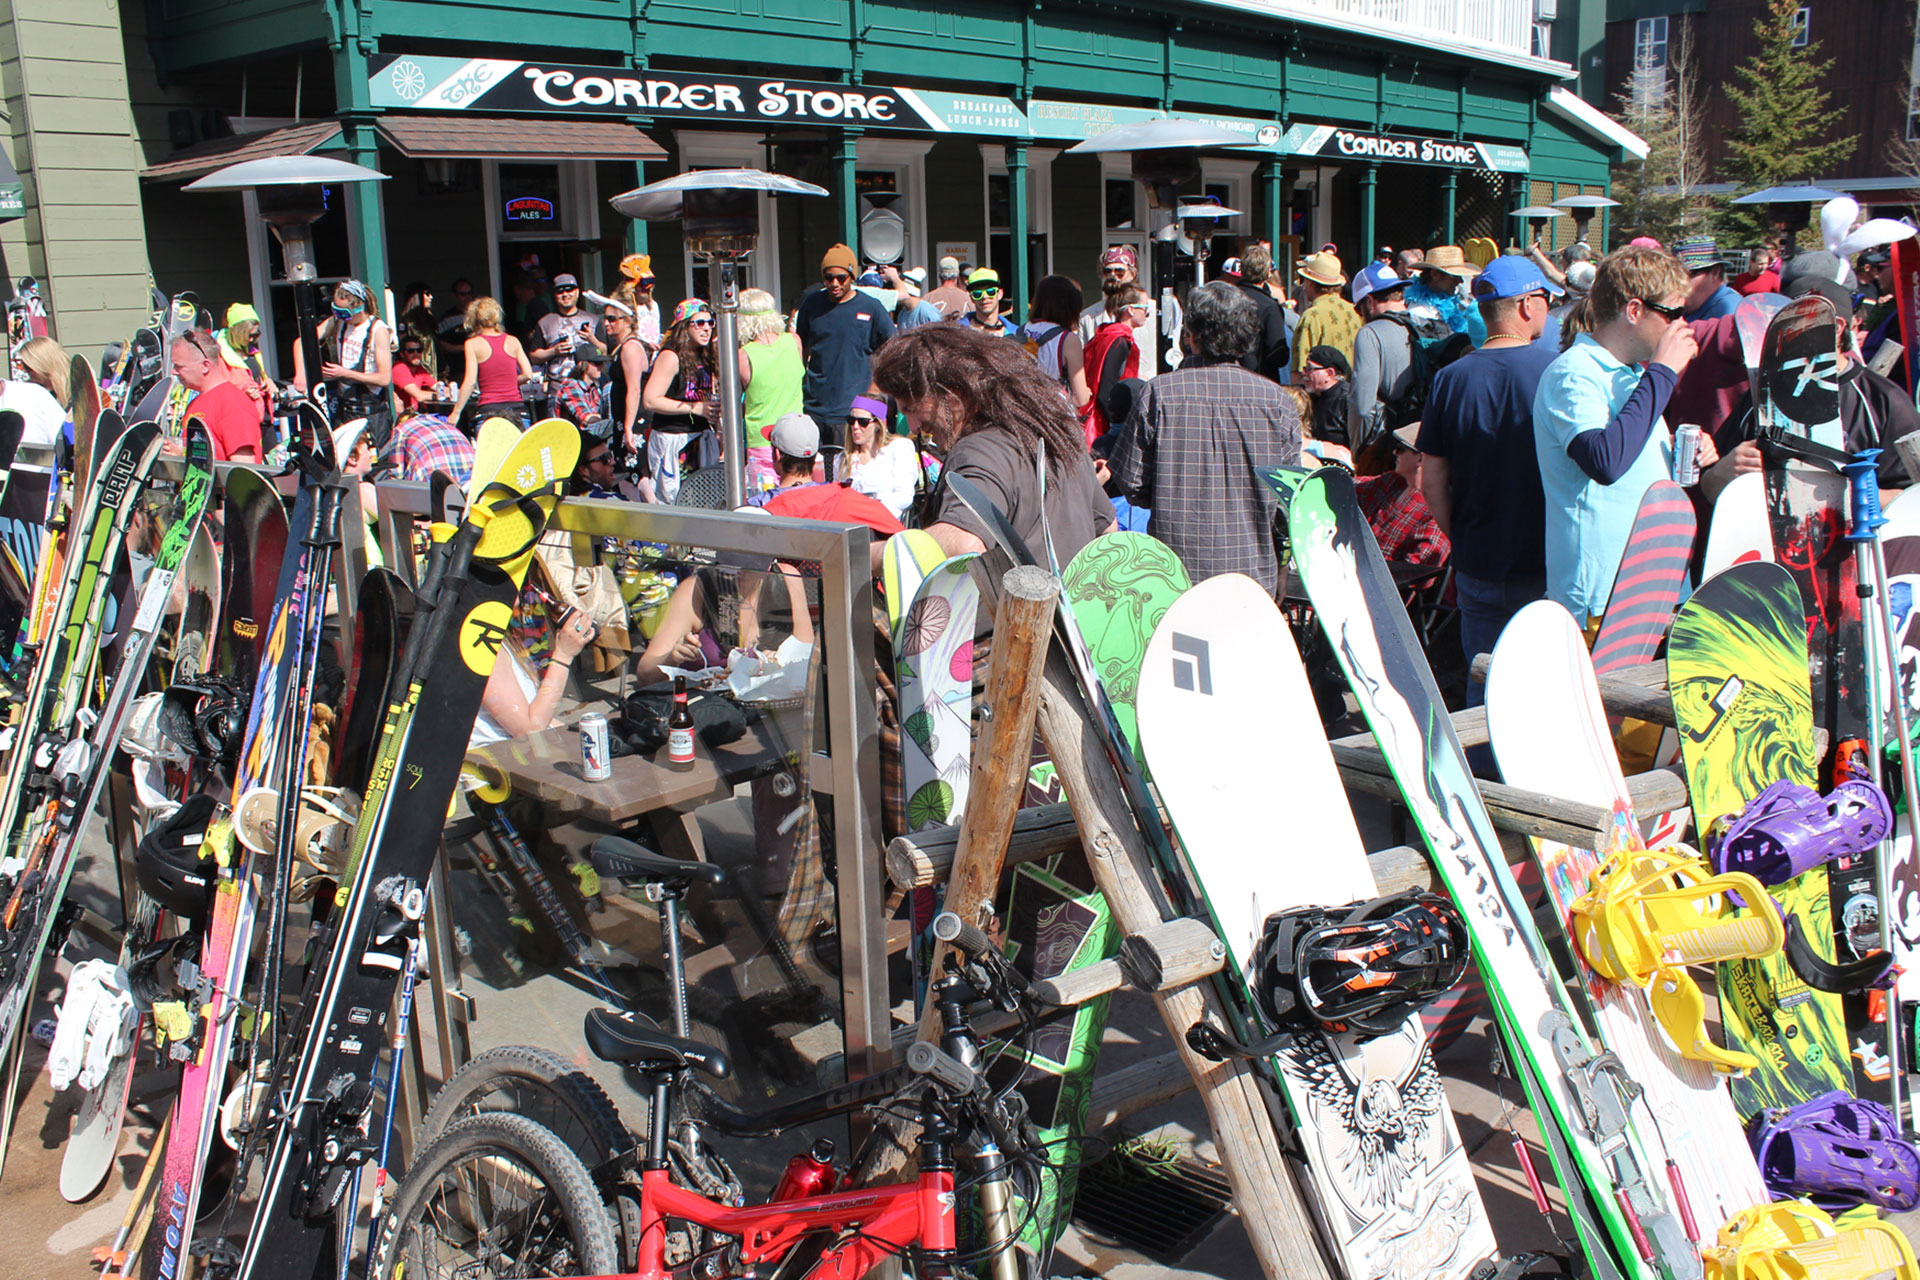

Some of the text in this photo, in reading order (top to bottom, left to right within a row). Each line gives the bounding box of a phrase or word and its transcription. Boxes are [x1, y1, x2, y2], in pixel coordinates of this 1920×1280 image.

[523, 67, 896, 121] CORNER STORE
[953, 100, 1013, 115] BREAKFAST
[1038, 104, 1114, 122] RESORT PLAZA
[1335, 131, 1477, 164] CORNER STORE
[520, 211, 540, 220] ALES
[405, 763, 424, 774] SOUL
[409, 771, 423, 790] 7
[1731, 963, 1763, 1017] SKATE
[827, 1065, 908, 1110] GIAN
[160, 1181, 187, 1280] ATOM
